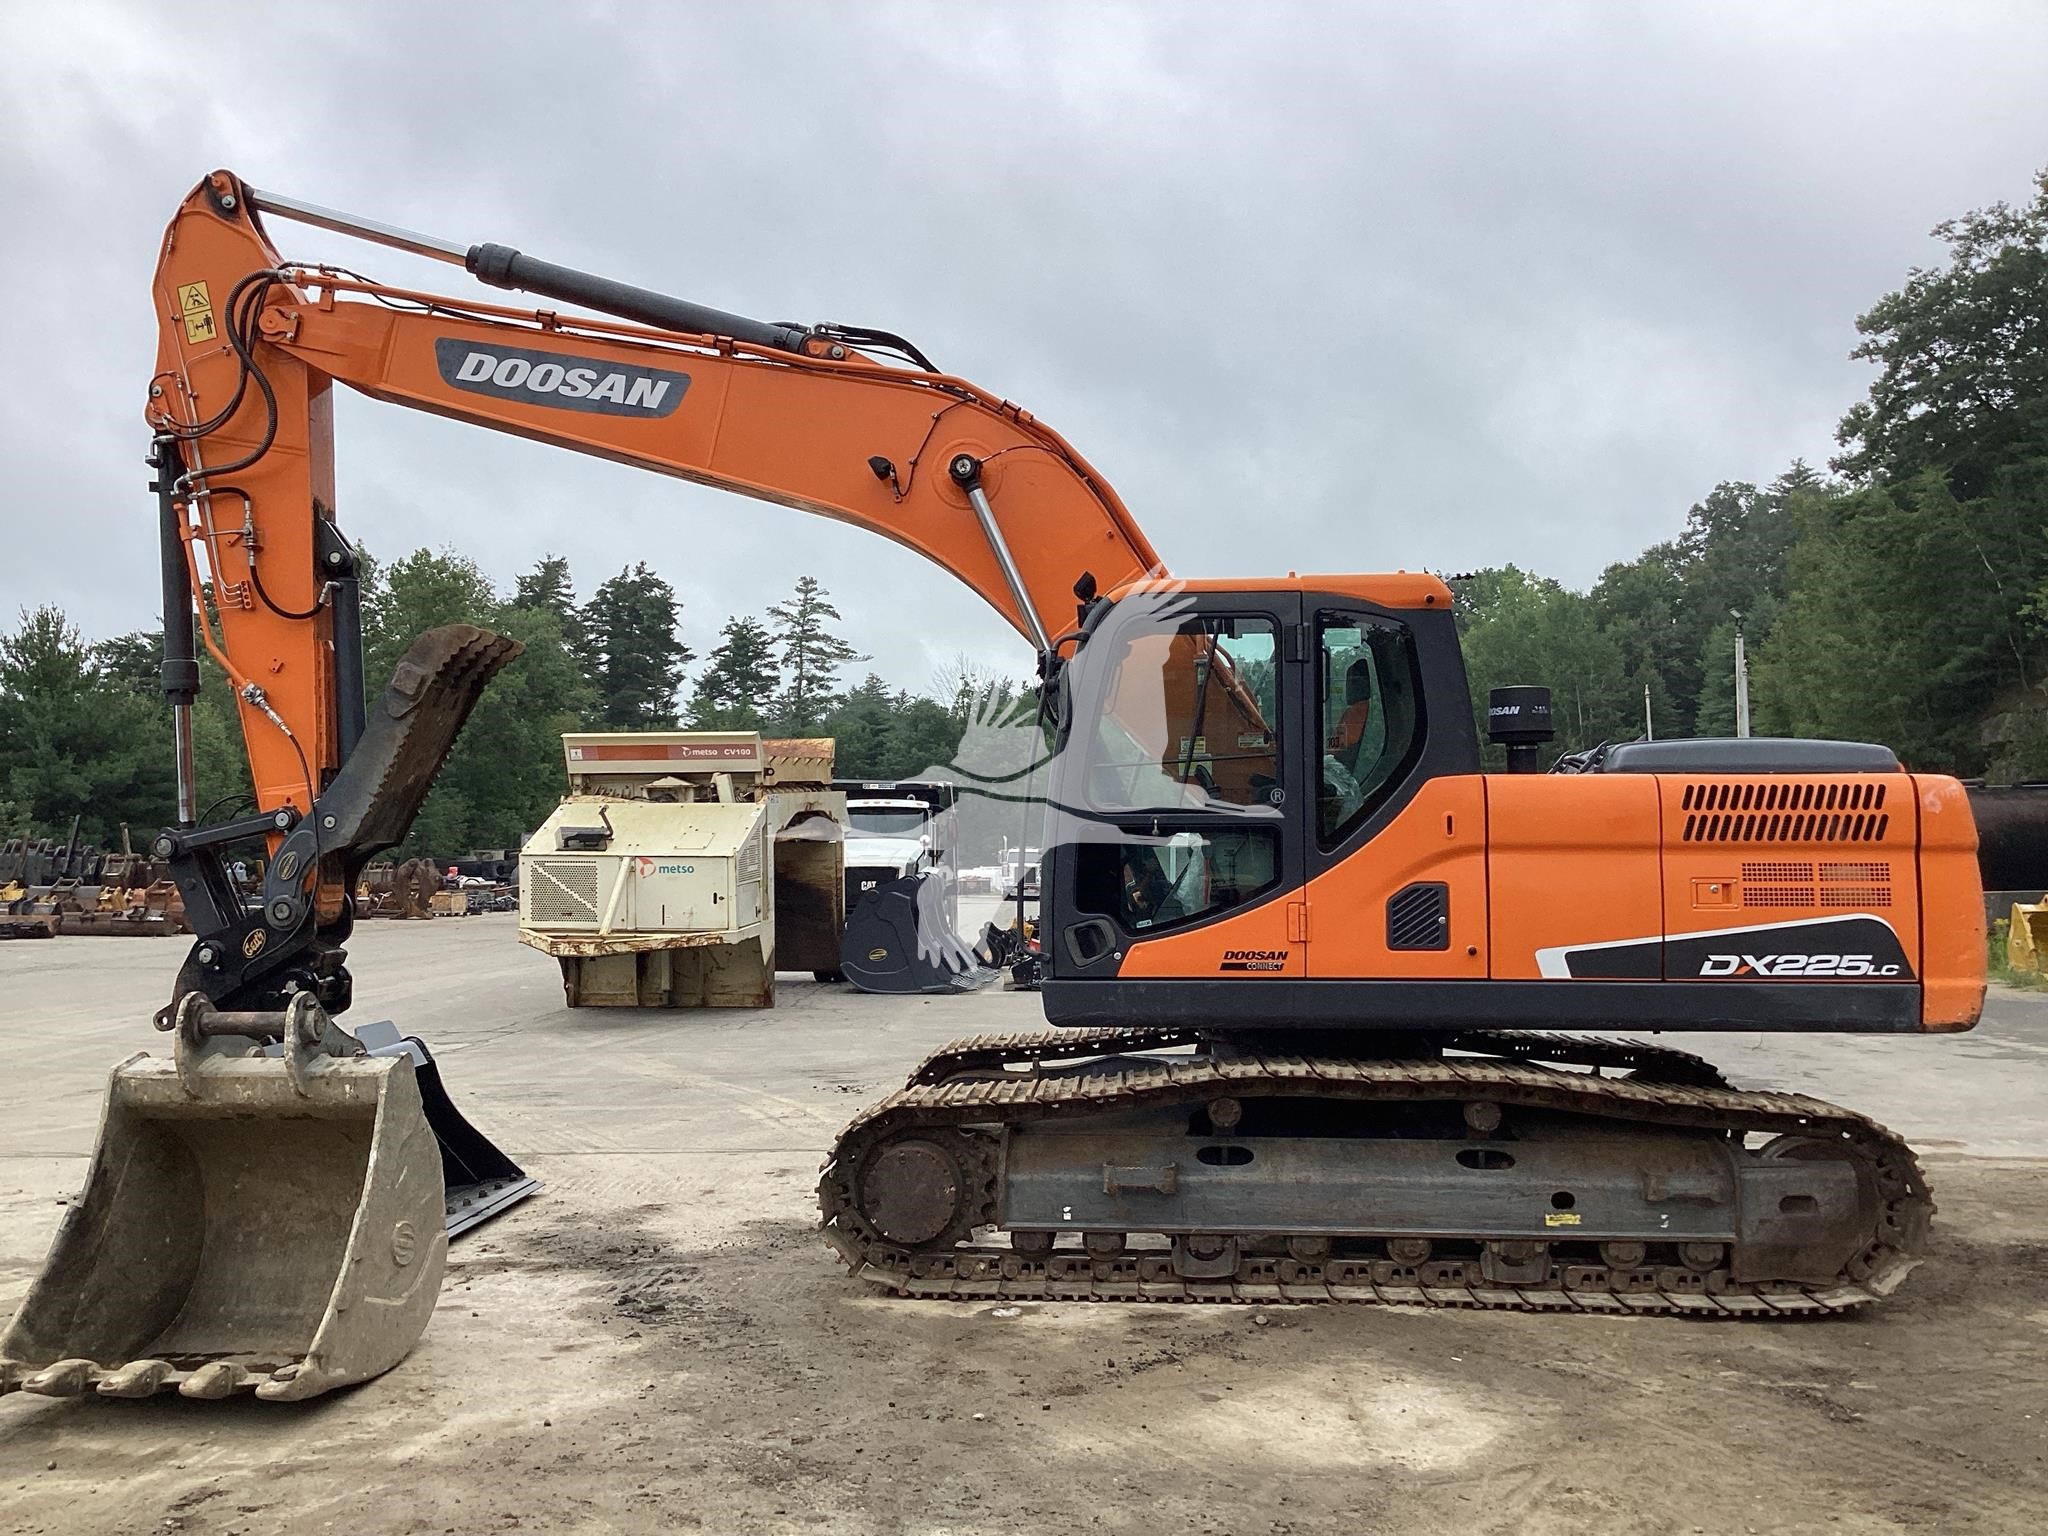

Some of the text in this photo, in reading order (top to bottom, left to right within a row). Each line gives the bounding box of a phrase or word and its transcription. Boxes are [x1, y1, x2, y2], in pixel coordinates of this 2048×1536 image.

[456, 352, 671, 409] DOOSAN
[1489, 705, 1520, 716] OSAN
[724, 748, 751, 756] CV100
[658, 864, 695, 874] metso
[861, 881, 877, 891] CAT
[1223, 951, 1289, 961] DOOSAN
[1246, 962, 1282, 970] CONNECT
